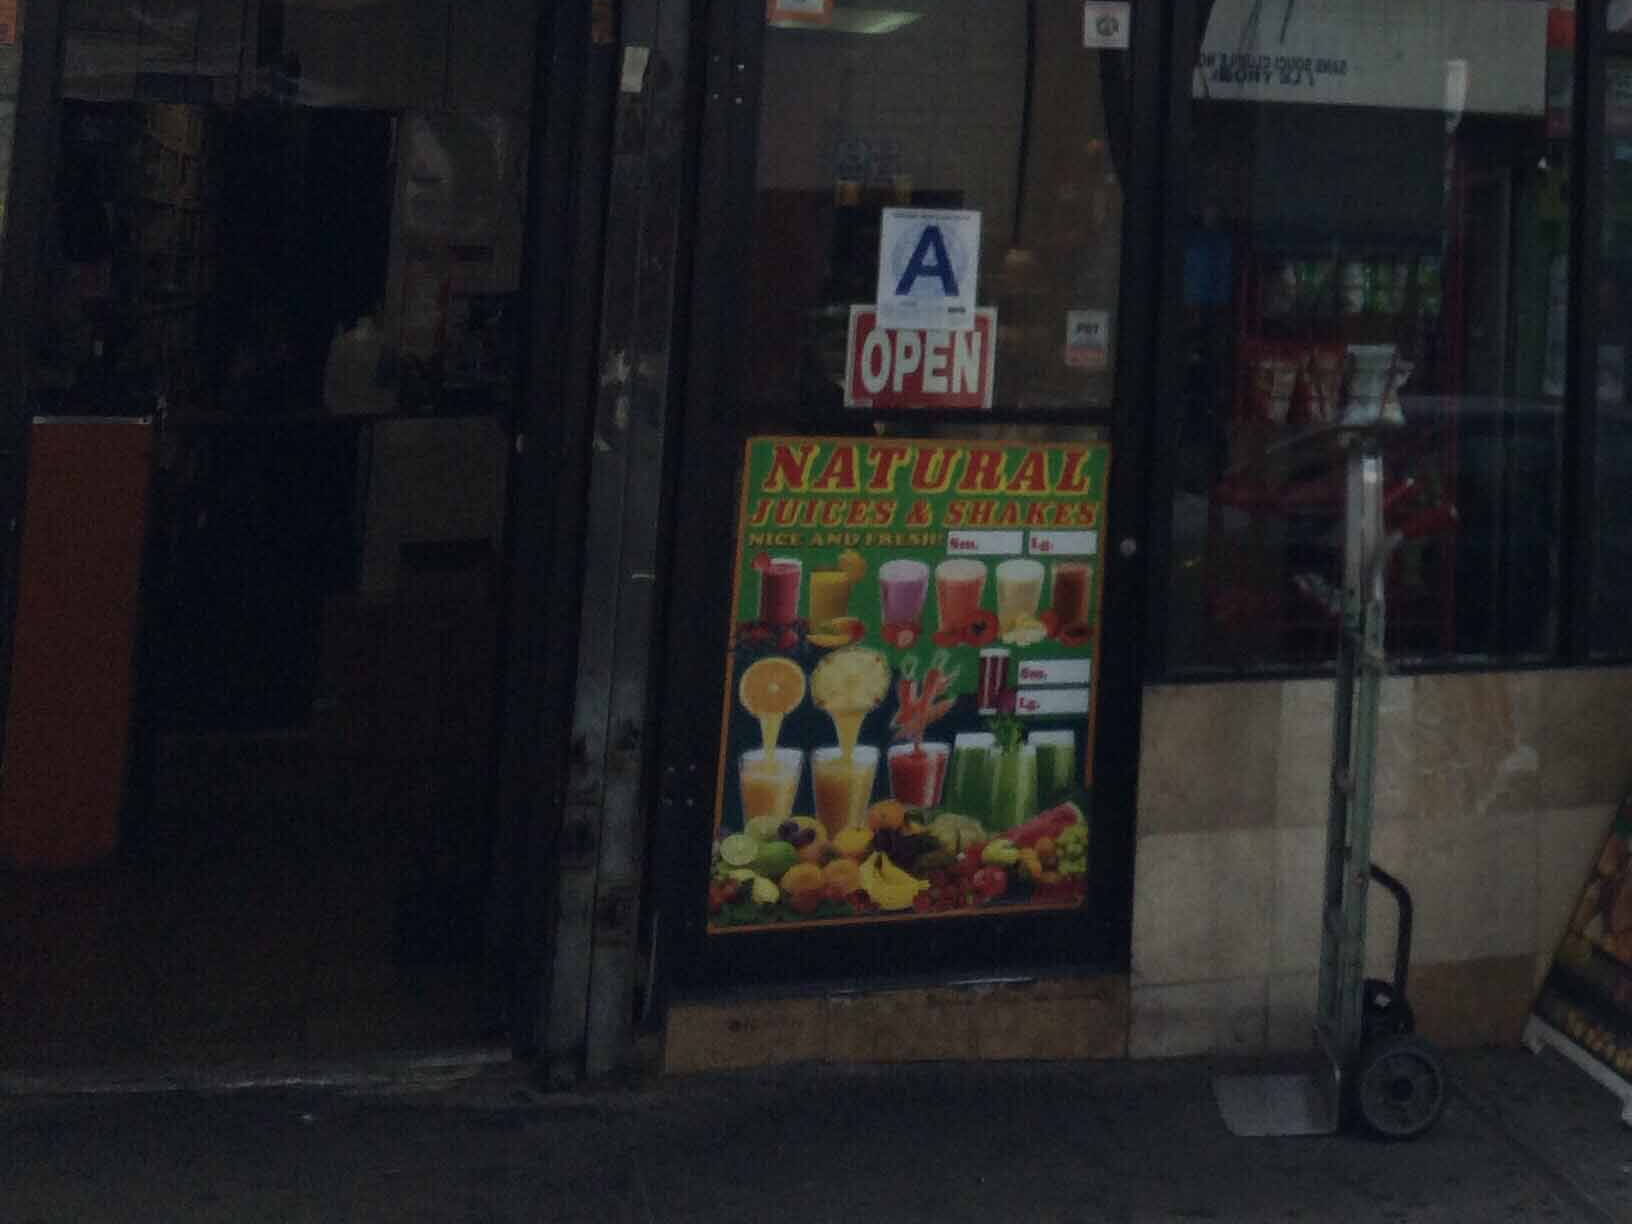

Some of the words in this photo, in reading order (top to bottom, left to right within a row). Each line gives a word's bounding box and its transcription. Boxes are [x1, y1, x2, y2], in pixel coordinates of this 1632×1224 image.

[894, 224, 960, 298] A
[860, 328, 984, 396] OPEN
[761, 442, 1092, 496] NATURAL
[750, 497, 897, 527] JUICES
[905, 500, 934, 527] &
[943, 498, 1101, 528] SHAKES
